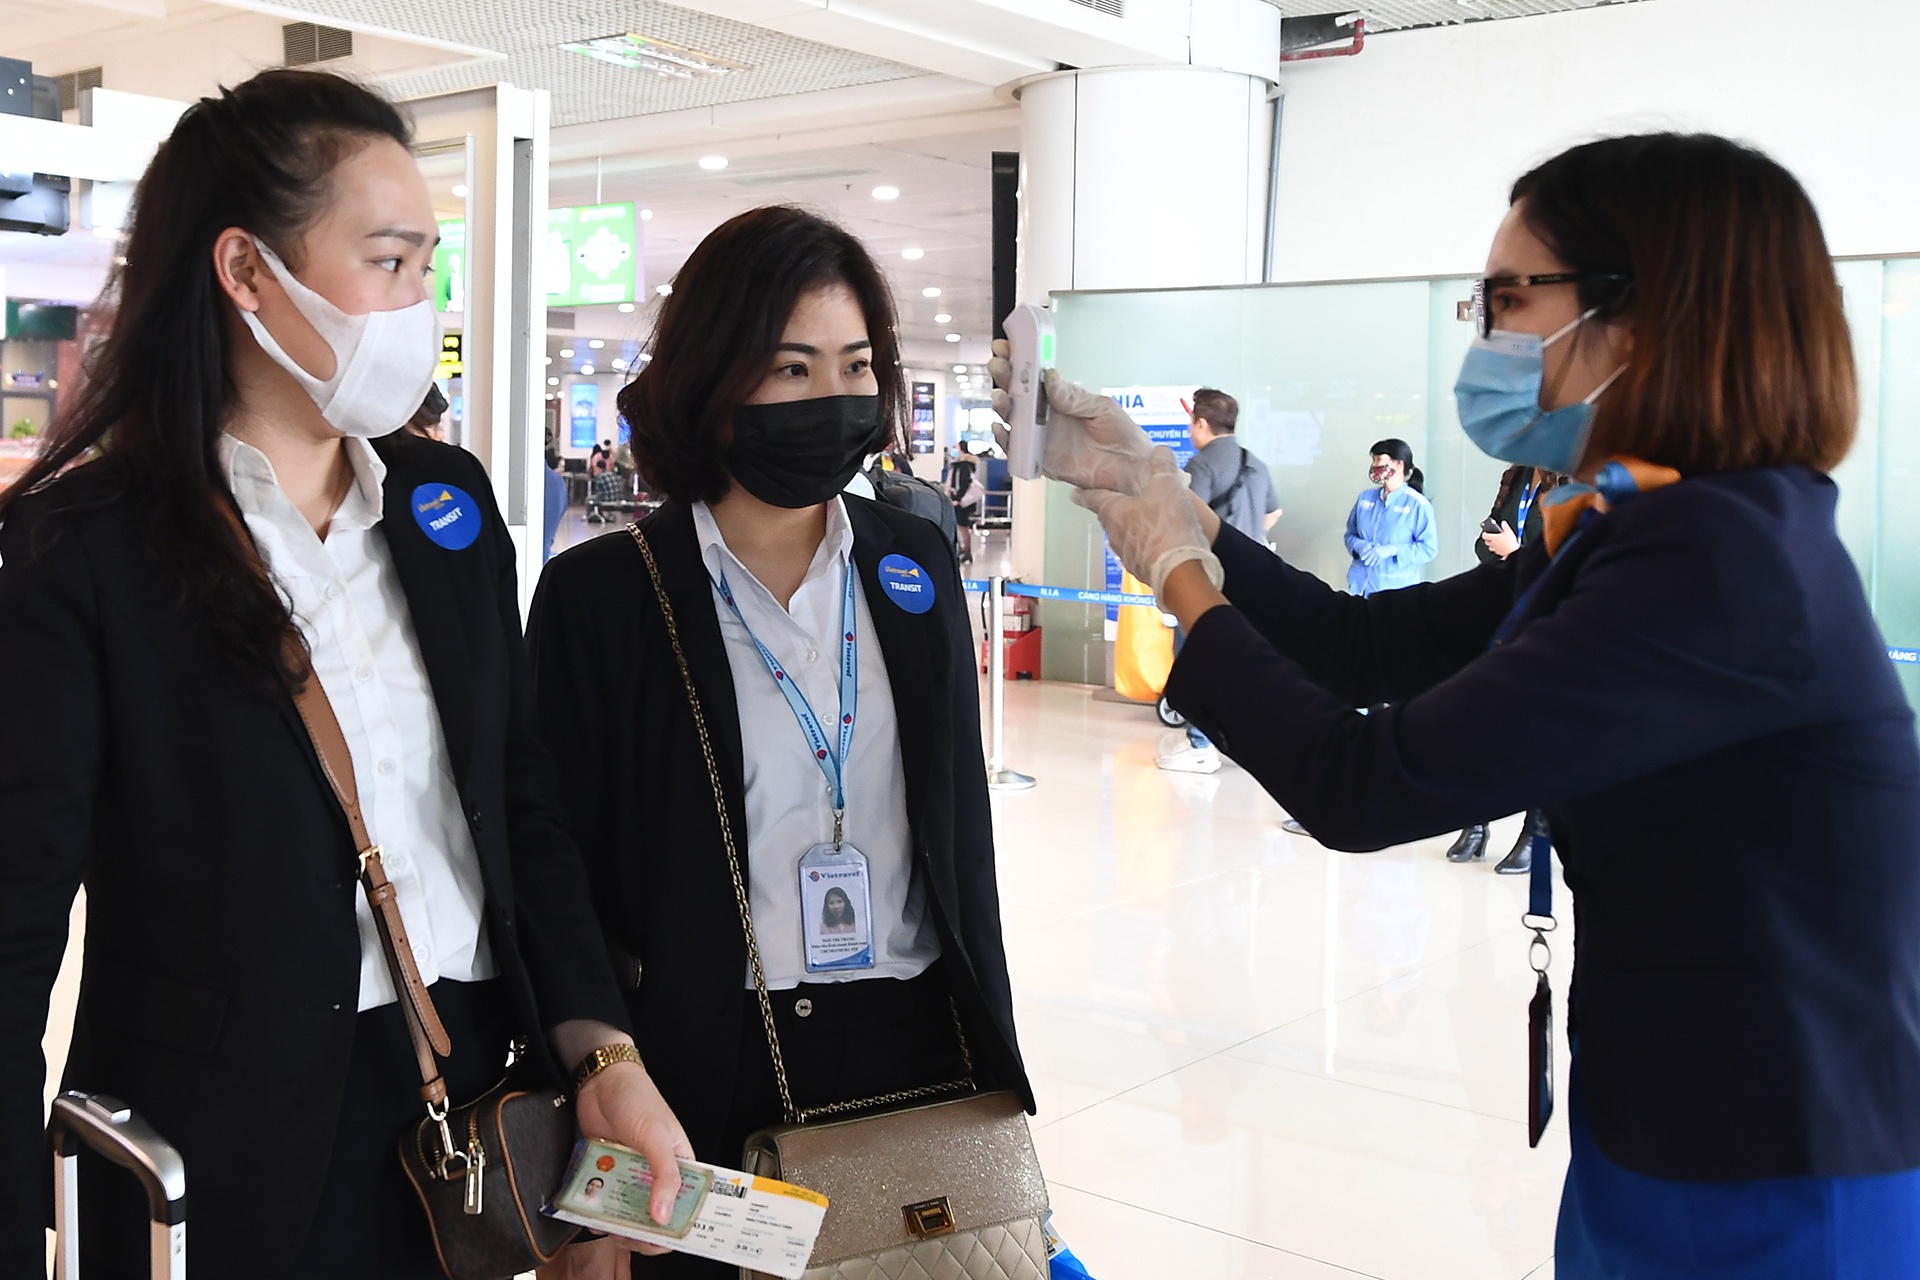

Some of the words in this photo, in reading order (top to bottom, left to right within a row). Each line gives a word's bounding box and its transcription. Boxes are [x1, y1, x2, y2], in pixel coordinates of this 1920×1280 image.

[429, 506, 463, 531] TRANSIT
[889, 581, 922, 593] TRANSIT
[801, 713, 822, 750] Vietravel
[820, 871, 860, 879] Vietravel
